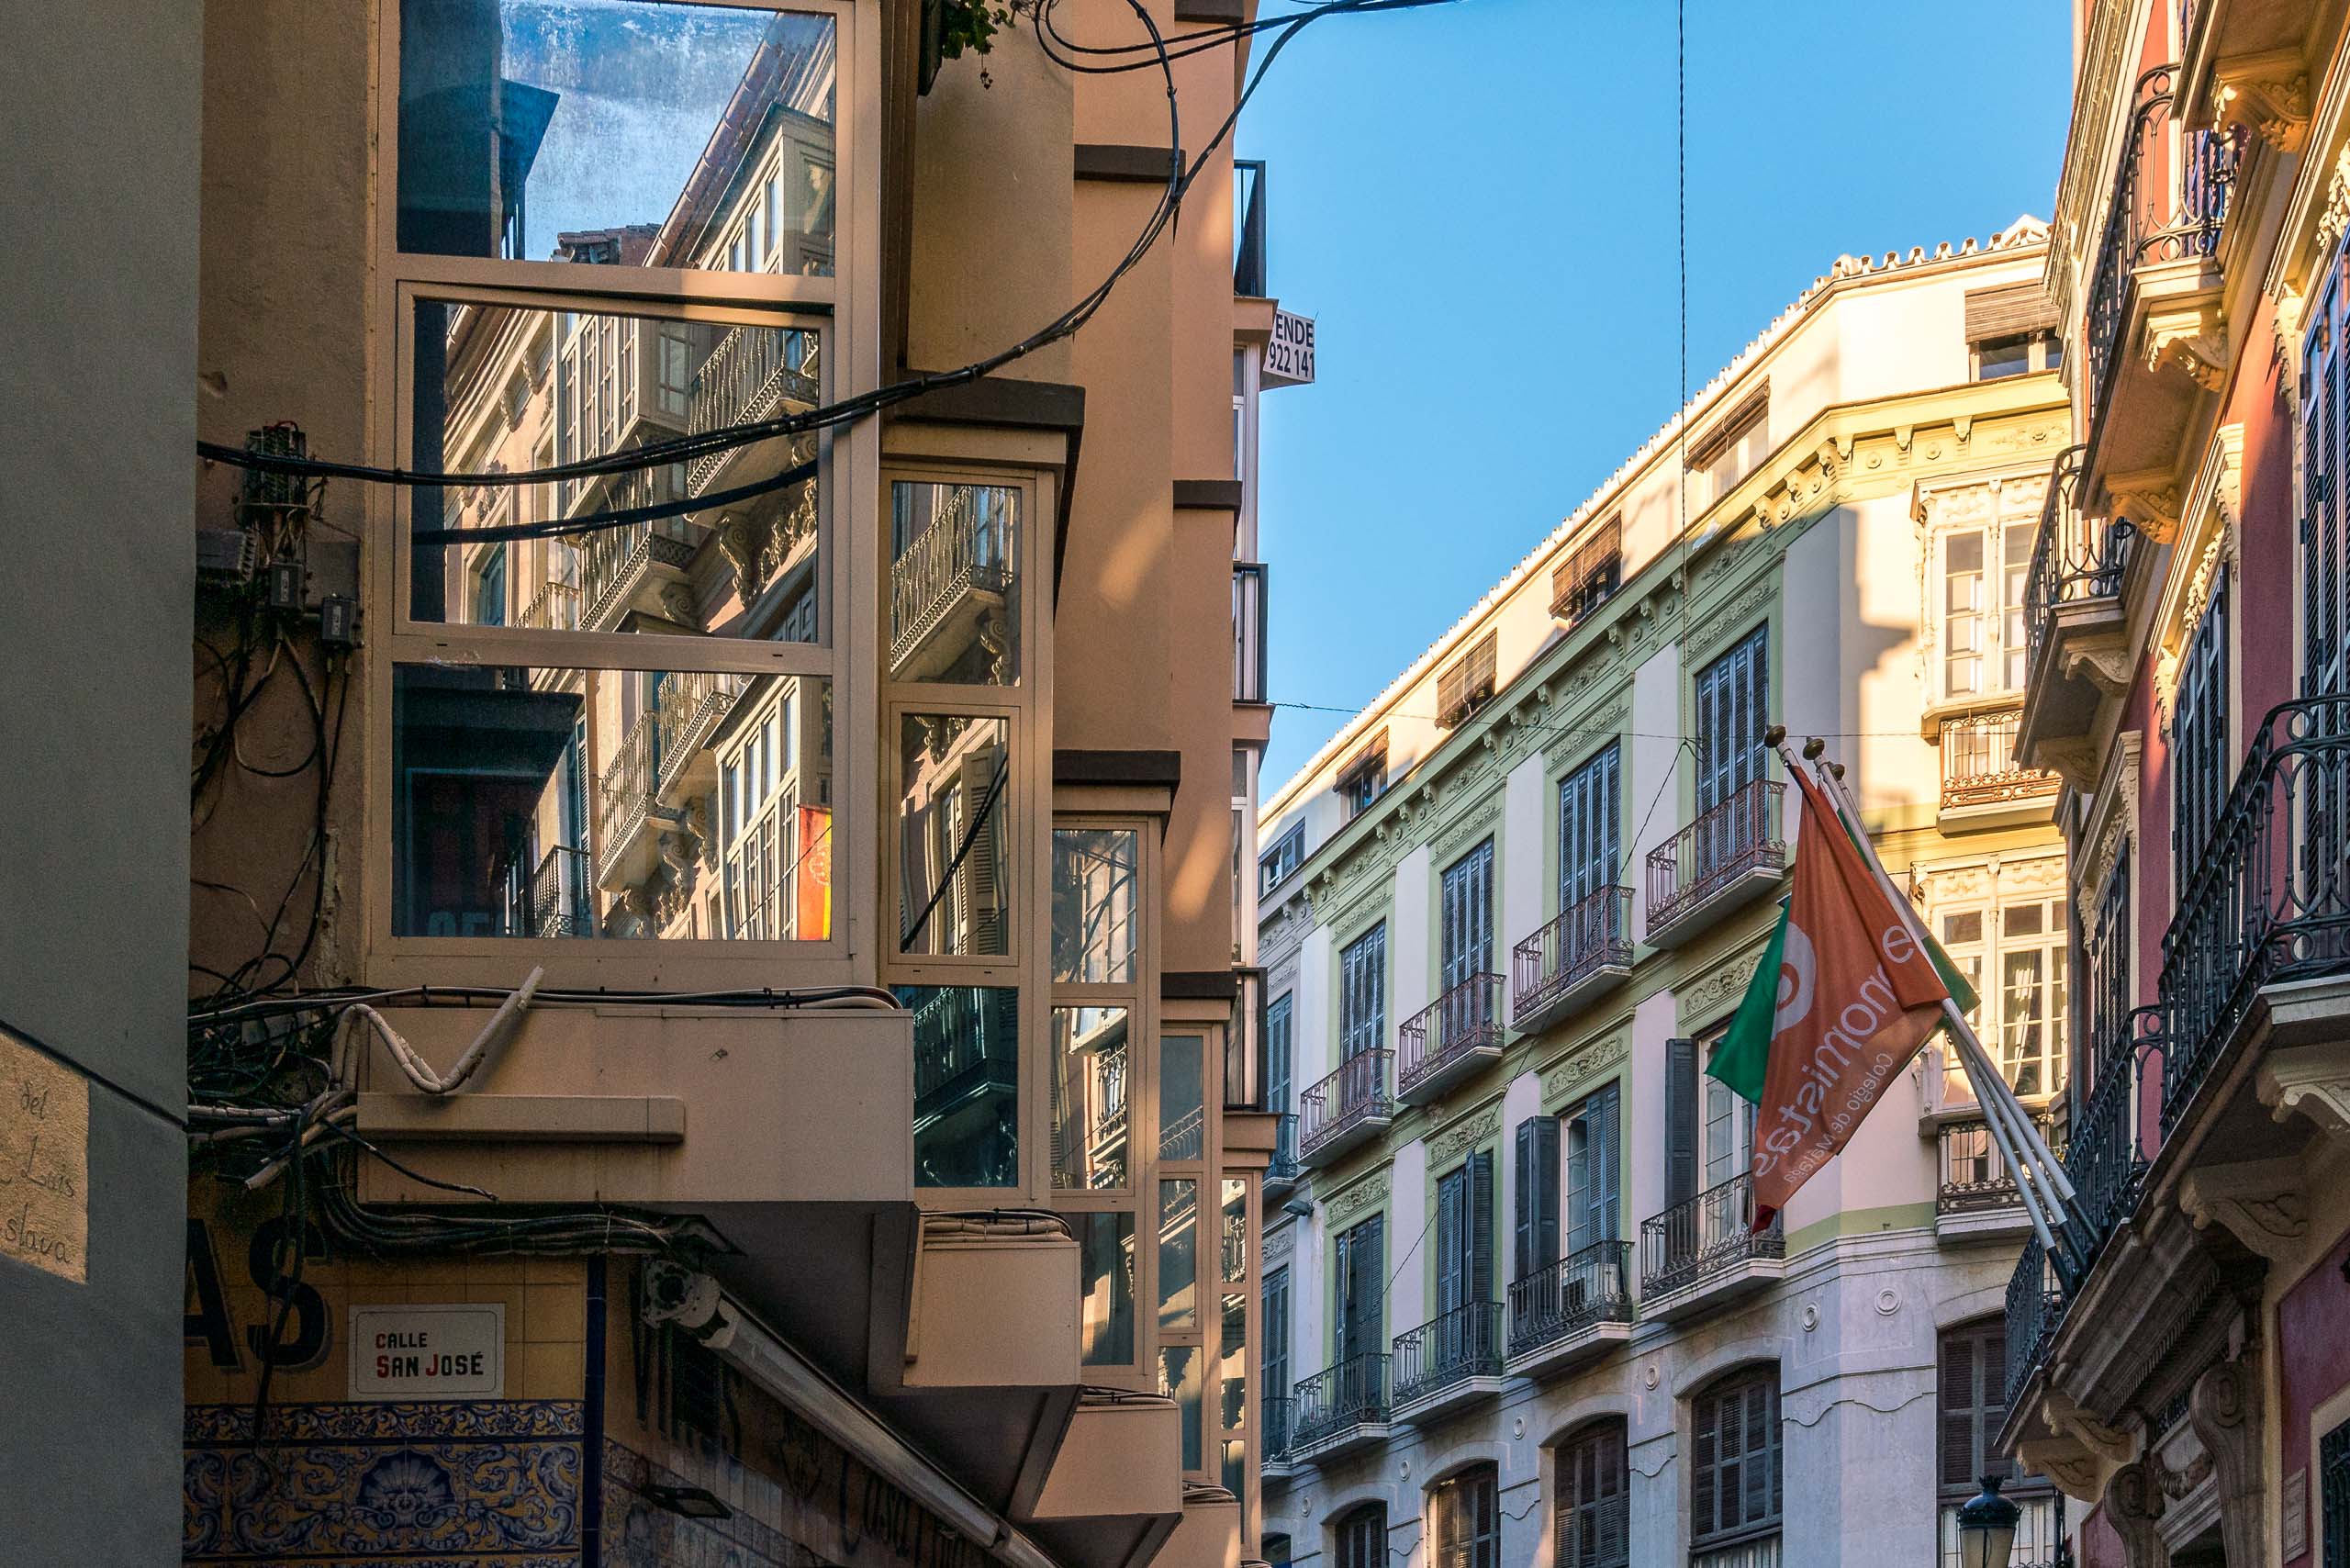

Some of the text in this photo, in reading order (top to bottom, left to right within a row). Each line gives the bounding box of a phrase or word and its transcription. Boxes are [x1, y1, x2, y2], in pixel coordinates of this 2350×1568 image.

[20, 1076, 49, 1120] del
[0, 1201, 72, 1264] slava
[375, 1332, 428, 1350] CALLE
[376, 1350, 484, 1379] SAN JOSÉ
